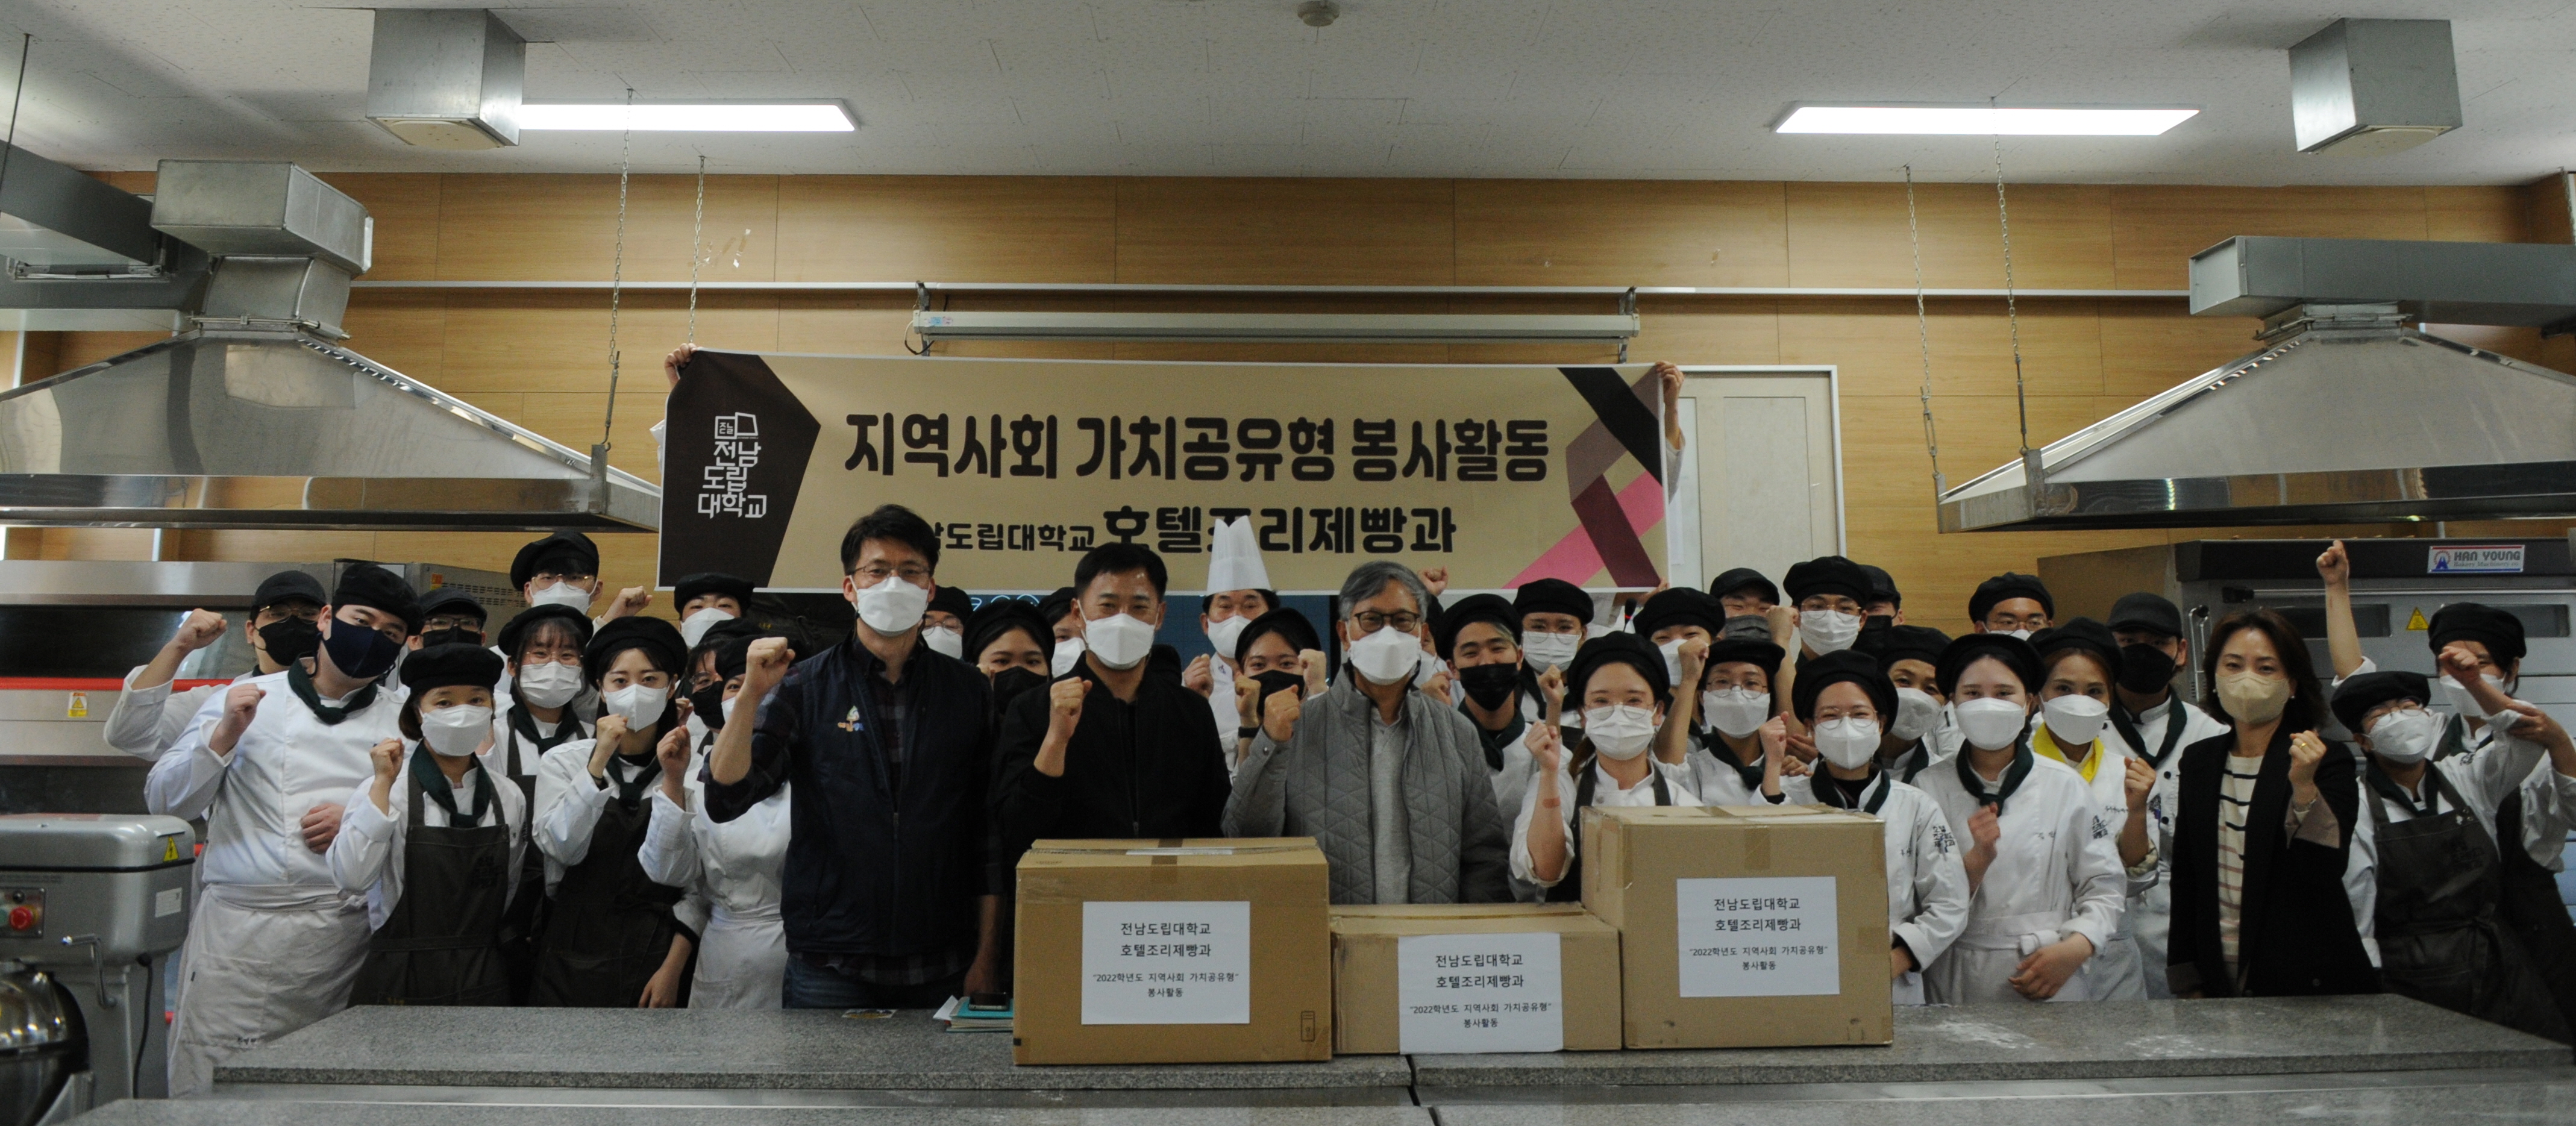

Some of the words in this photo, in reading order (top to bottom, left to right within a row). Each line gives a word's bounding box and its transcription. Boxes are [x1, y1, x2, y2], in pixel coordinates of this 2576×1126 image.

[713, 440, 762, 468] 전남
[844, 413, 1058, 480] 지역사회
[1076, 415, 1335, 483] 가치공유형
[1351, 418, 1549, 482] 봉사활동
[702, 466, 748, 492] 도립
[697, 492, 767, 519] 대학교
[935, 522, 1096, 551] 도립대학교
[2454, 551, 2478, 561] HAN
[2483, 551, 2521, 561] YOUNG
[1715, 898, 1800, 911] 전남도립대학교
[1121, 922, 1211, 936] 전남도립대학교
[1715, 918, 1801, 932] 호텔조리제빵과
[1121, 943, 1211, 957] 호텔조리제빵과
[1743, 946, 1777, 956] 지역사회
[1435, 954, 1523, 968] 전남도립대학교
[1742, 961, 1776, 971] 봉사활동
[1149, 972, 1185, 983] 지역사회
[1436, 975, 1524, 989] 호텔조리제빵과
[1147, 987, 1183, 998] 봉사활동
[1464, 1003, 1499, 1013] 지역사회
[1463, 1018, 1499, 1028] 봉사활동
